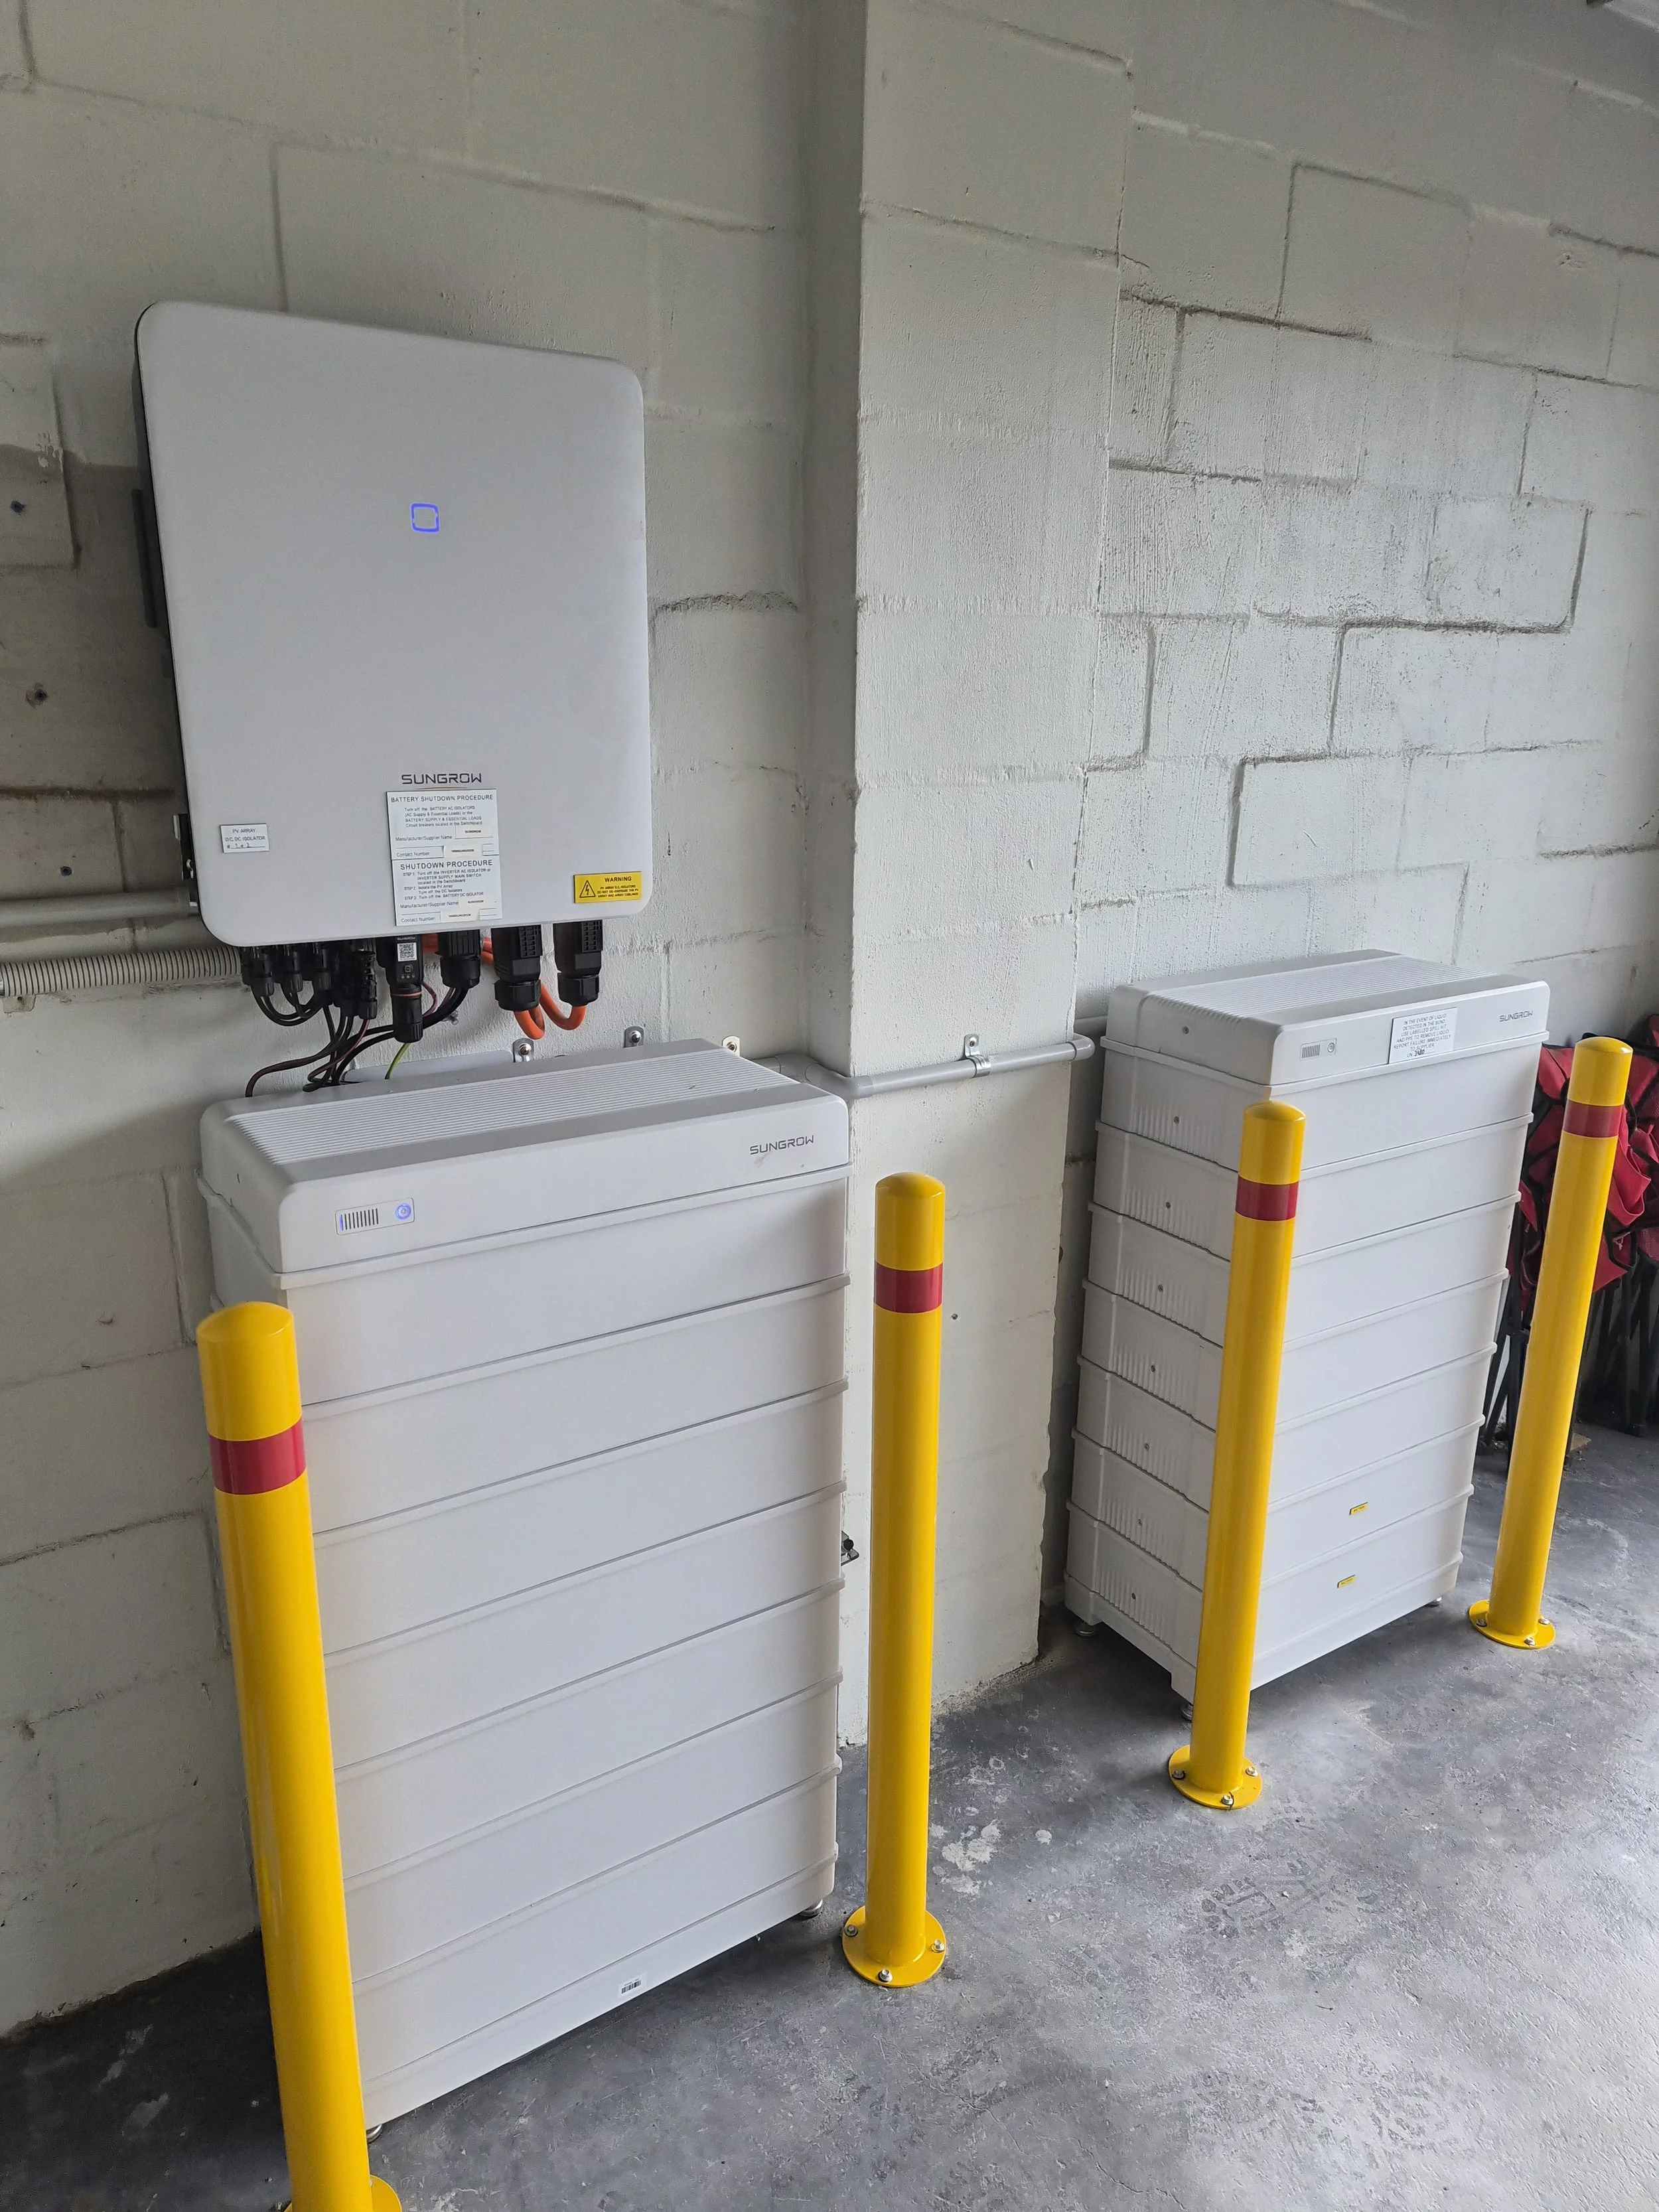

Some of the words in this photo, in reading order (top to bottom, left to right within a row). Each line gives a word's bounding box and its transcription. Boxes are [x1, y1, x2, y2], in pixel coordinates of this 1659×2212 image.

[401, 773, 482, 784] SUNGROW
[1499, 1009, 1533, 1021] SUNGROW
[750, 1135, 814, 1155] SUNGROW
